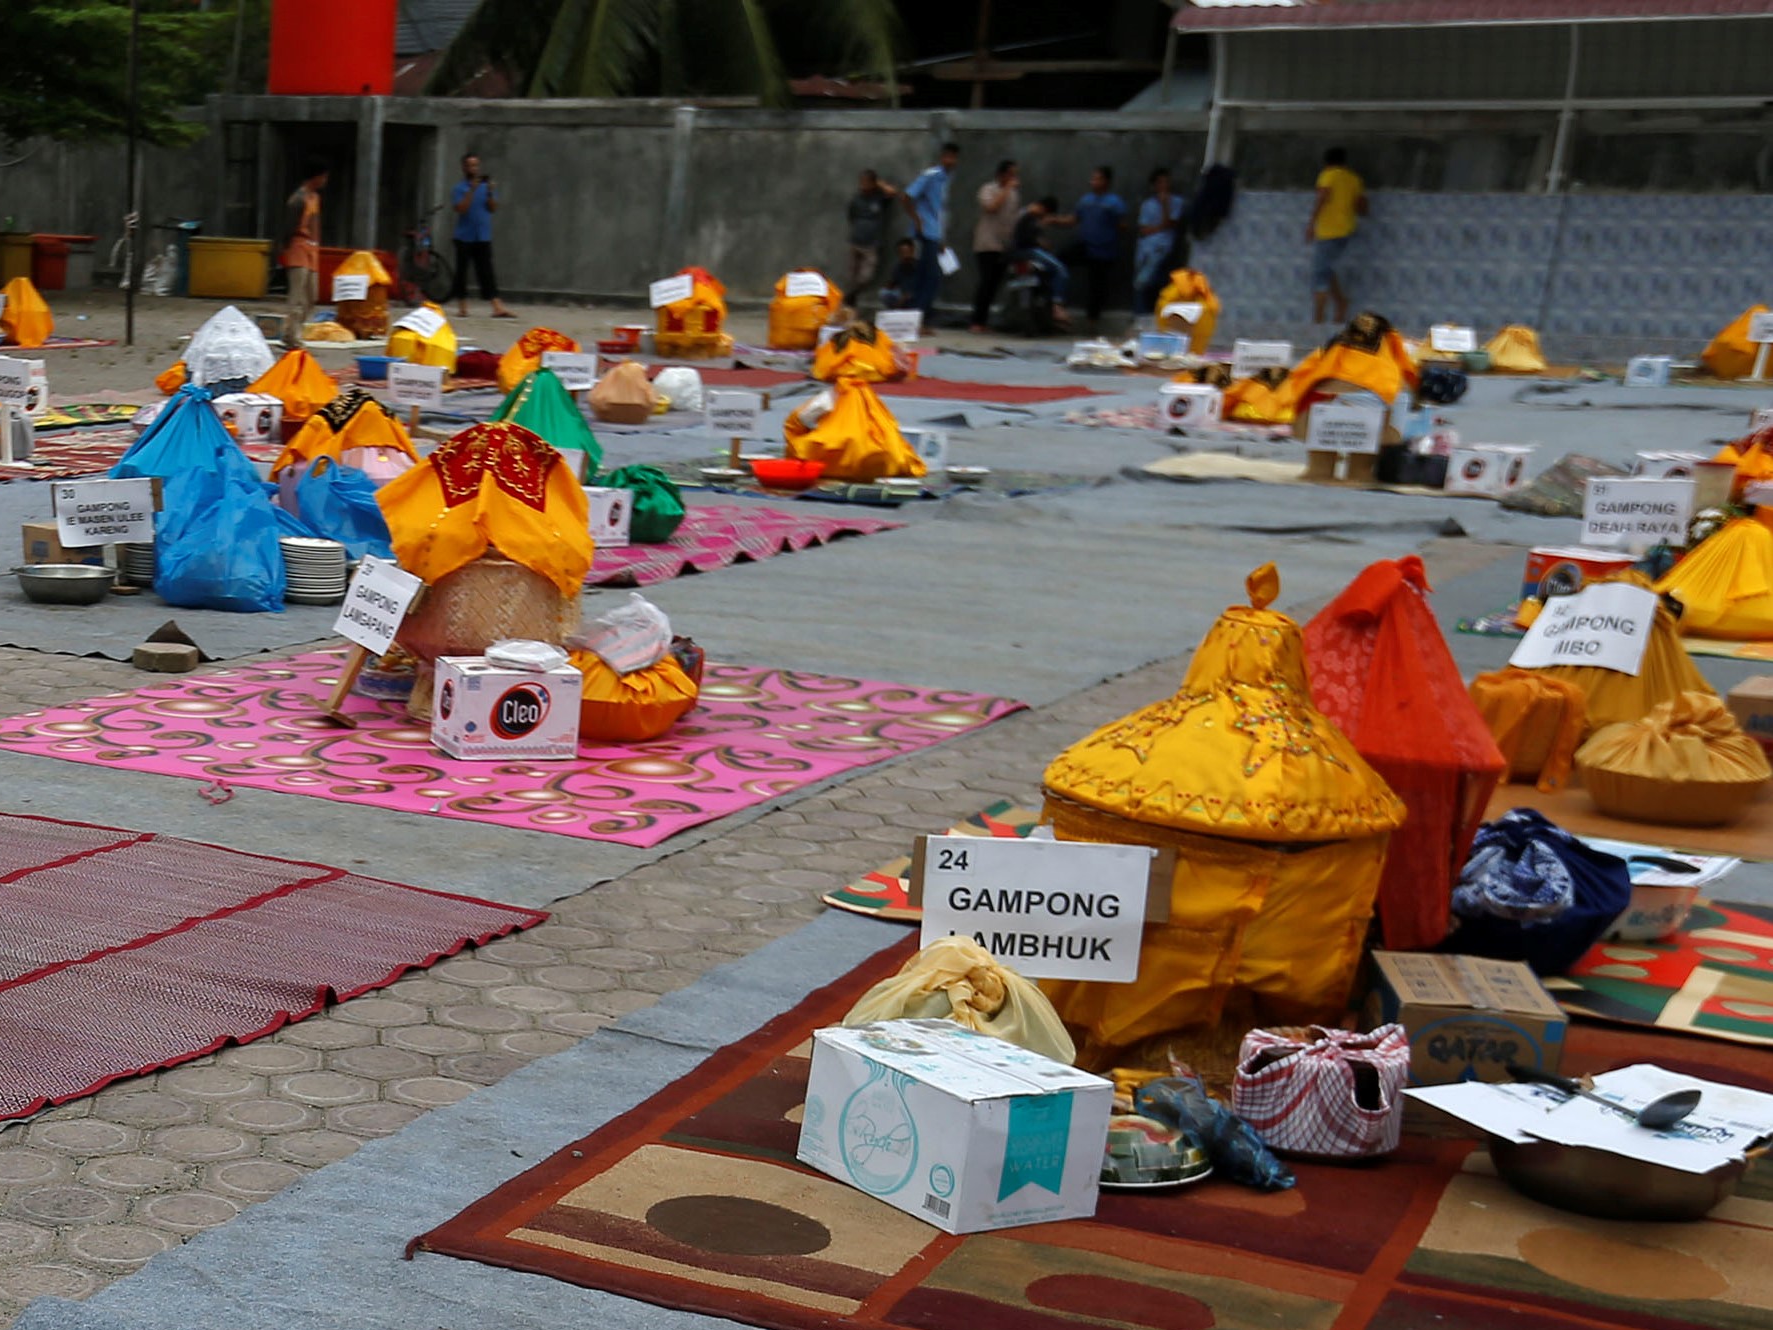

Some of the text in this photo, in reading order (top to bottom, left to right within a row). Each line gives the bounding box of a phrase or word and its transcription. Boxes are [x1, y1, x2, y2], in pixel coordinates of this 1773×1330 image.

[76, 501, 131, 513] GAMPONG
[1595, 502, 1677, 515] GAMPONG
[84, 525, 129, 536] KARENG
[1588, 521, 1680, 534] DEAH RAYA
[356, 584, 399, 615] GAMPONG
[502, 700, 539, 724] Cleo
[938, 850, 969, 870] 24
[948, 887, 1121, 919] GAMPONG
[950, 930, 1113, 962] AMBHUK
[1428, 1033, 1520, 1068] QATAR
